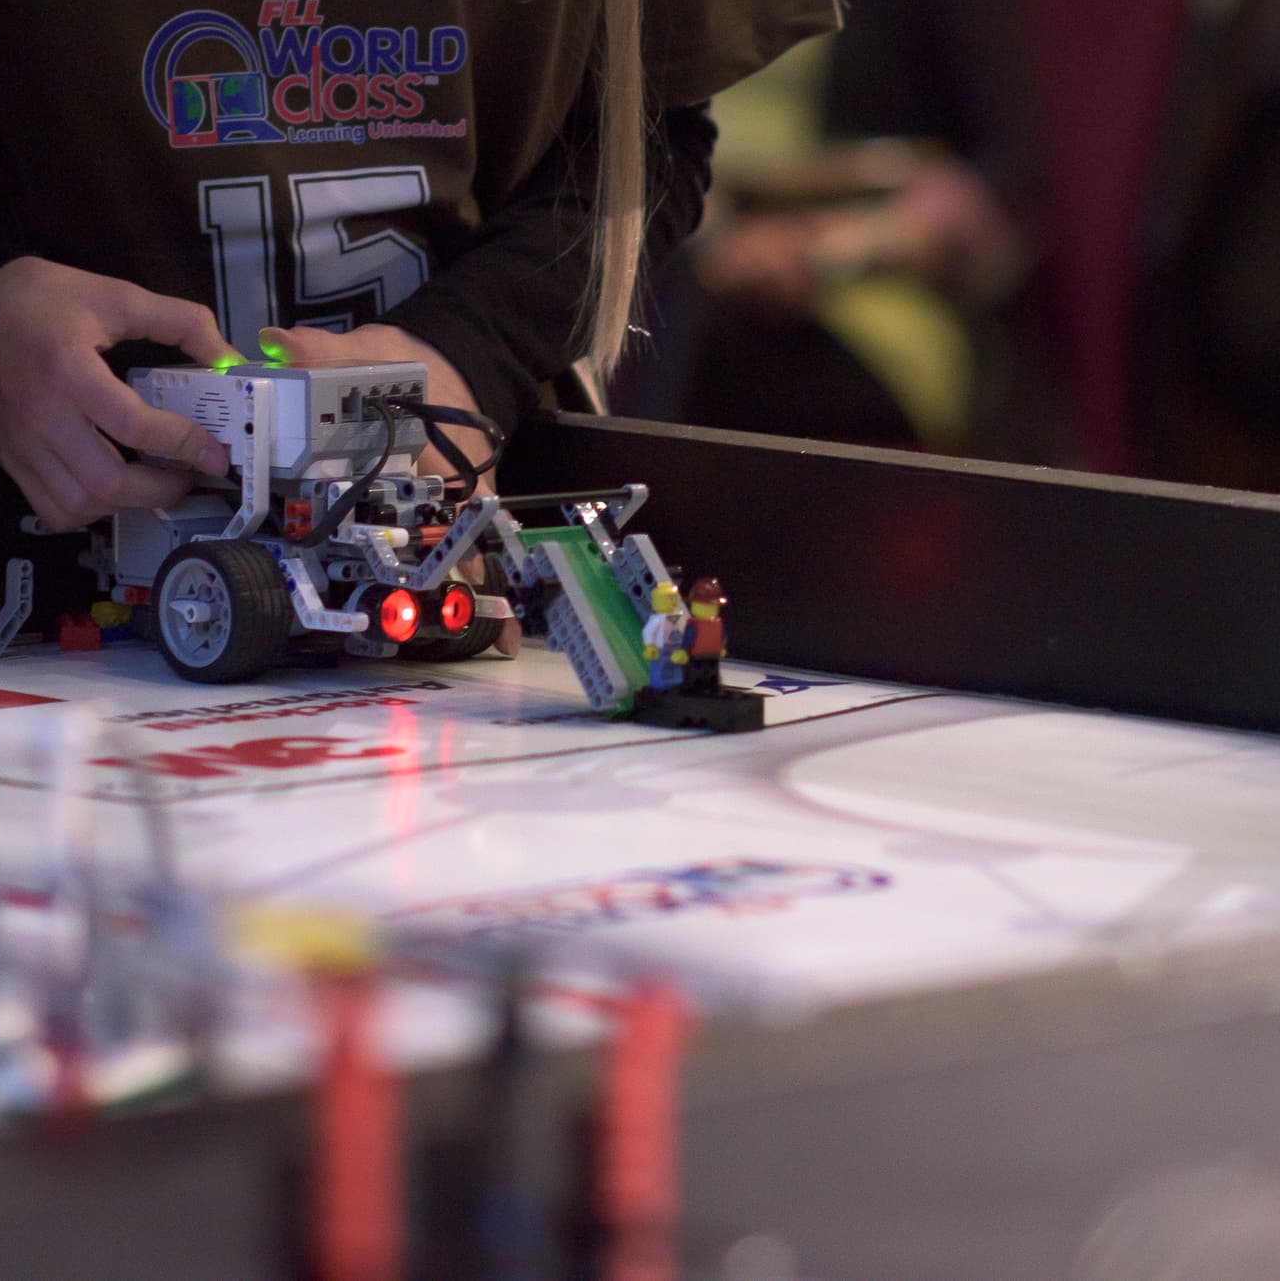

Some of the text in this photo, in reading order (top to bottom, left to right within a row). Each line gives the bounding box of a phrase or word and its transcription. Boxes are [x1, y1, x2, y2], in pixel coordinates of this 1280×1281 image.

[259, 24, 468, 77] WORLD
[287, 123, 365, 145] Learning
[198, 165, 431, 363] 15
